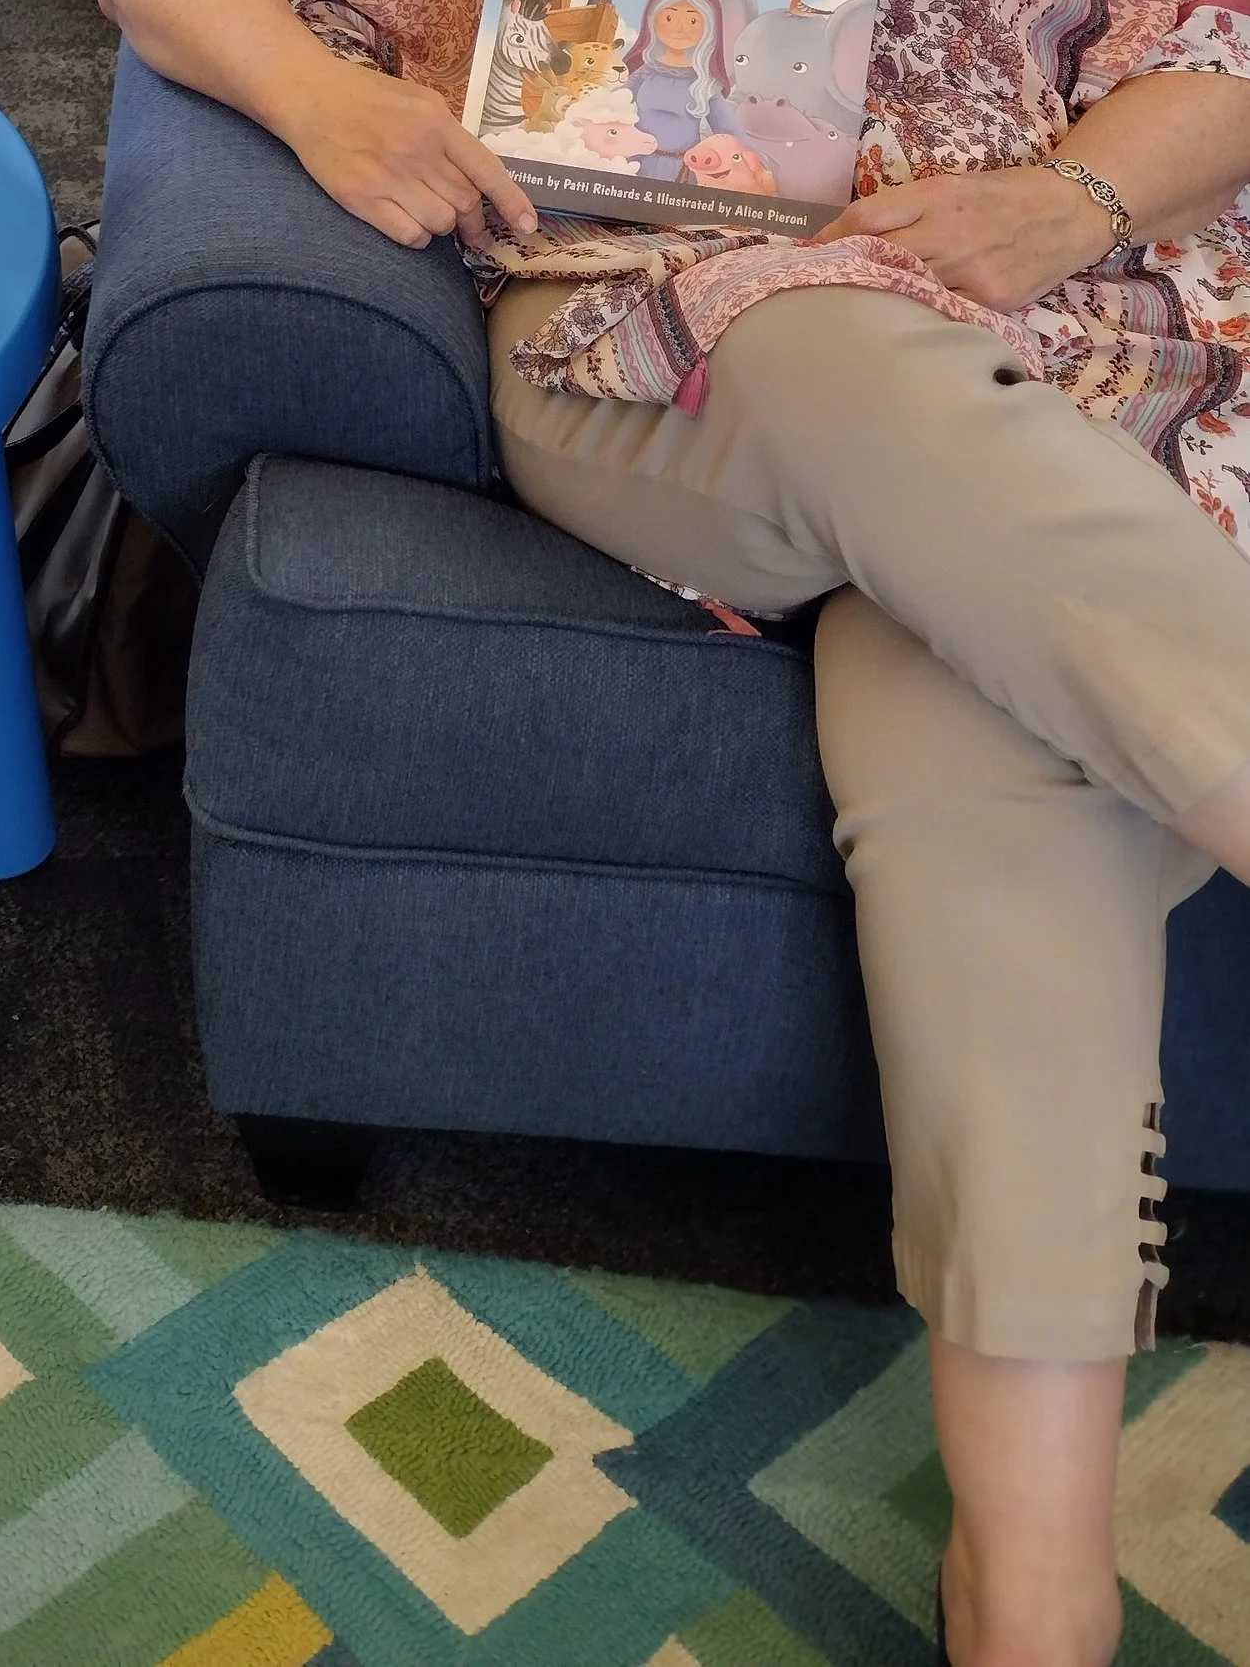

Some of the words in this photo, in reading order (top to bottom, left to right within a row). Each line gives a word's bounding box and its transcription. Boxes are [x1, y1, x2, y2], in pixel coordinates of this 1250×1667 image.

[506, 168, 544, 186] Written
[547, 175, 560, 191] by
[564, 178, 590, 195] Patti
[593, 181, 641, 202] Richards
[644, 191, 653, 203] &
[656, 192, 715, 212] Illustrated
[718, 201, 732, 217] by
[734, 204, 764, 220] Alice
[767, 209, 808, 227] Pieroni
